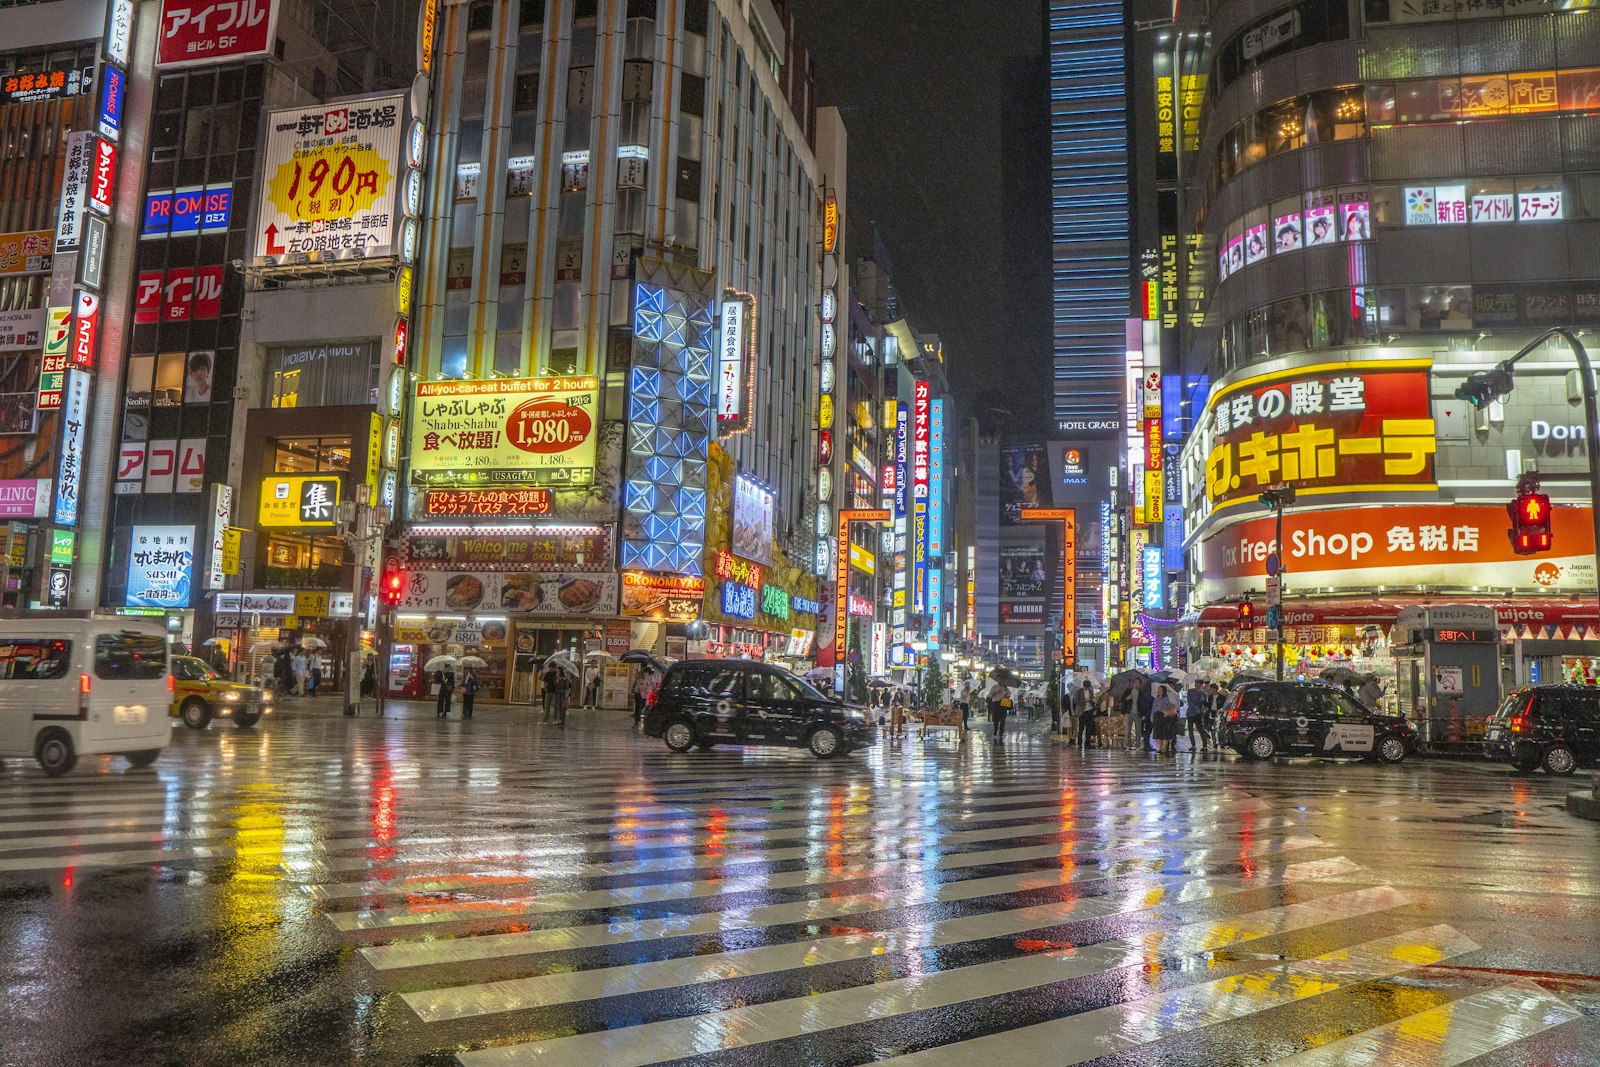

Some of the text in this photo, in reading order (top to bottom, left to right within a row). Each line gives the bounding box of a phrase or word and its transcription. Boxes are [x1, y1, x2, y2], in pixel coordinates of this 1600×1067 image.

[166, 0, 265, 38] アイフル
[218, 36, 237, 48] 5F
[106, 73, 119, 114] PROMISE
[103, 113, 117, 126] プロミス
[276, 105, 396, 137] 一軒め酒場
[1157, 76, 1174, 153] 驚安の殿堂
[104, 127, 113, 135] 6F
[95, 155, 111, 201] アイフル
[288, 155, 379, 201] 190円
[150, 194, 229, 217] PROMISE
[1309, 204, 1365, 218] Cafe
[1437, 196, 1560, 222] 新宿 アイドル ステージ
[194, 213, 227, 225] プロミス
[288, 233, 380, 253] 左の路地を右へ
[139, 276, 222, 304] アイフル
[170, 307, 185, 317] 5F
[77, 320, 91, 354] アコム
[726, 306, 738, 357] 居酒屋食堂
[77, 354, 87, 363] 3F
[420, 376, 595, 396] All-you-can-eat buffet for 2 hours
[126, 397, 150, 405] Neolive
[423, 398, 506, 417] しゃぶしゃぶ
[1215, 376, 1366, 437] 驚安の殿堂
[516, 418, 583, 447] 1,980 yen
[915, 385, 929, 480] カラオケ歌広場
[1060, 421, 1087, 430] HOTEL
[1531, 421, 1586, 440] Don
[119, 448, 204, 477] アコム
[465, 455, 489, 467] 2,480
[540, 454, 564, 466] 1,480
[571, 468, 592, 482] 5F
[123, 483, 136, 492] 3F
[302, 483, 333, 519] 集
[472, 501, 502, 513] パスタ
[508, 501, 549, 513] スイーツ
[54, 537, 72, 546] レイク
[140, 536, 188, 545] 築地海鮮
[1221, 528, 1374, 569] Tax Free Shop
[1386, 525, 1480, 553] 免税店
[839, 532, 847, 599] GODZILLA
[626, 575, 705, 589] OKONOMI YAKI
[1147, 550, 1160, 606] カラオケ
[1576, 578, 1594, 586] Shop
[1013, 604, 1043, 614] MARUHAN
[1131, 628, 1144, 639] 2F
